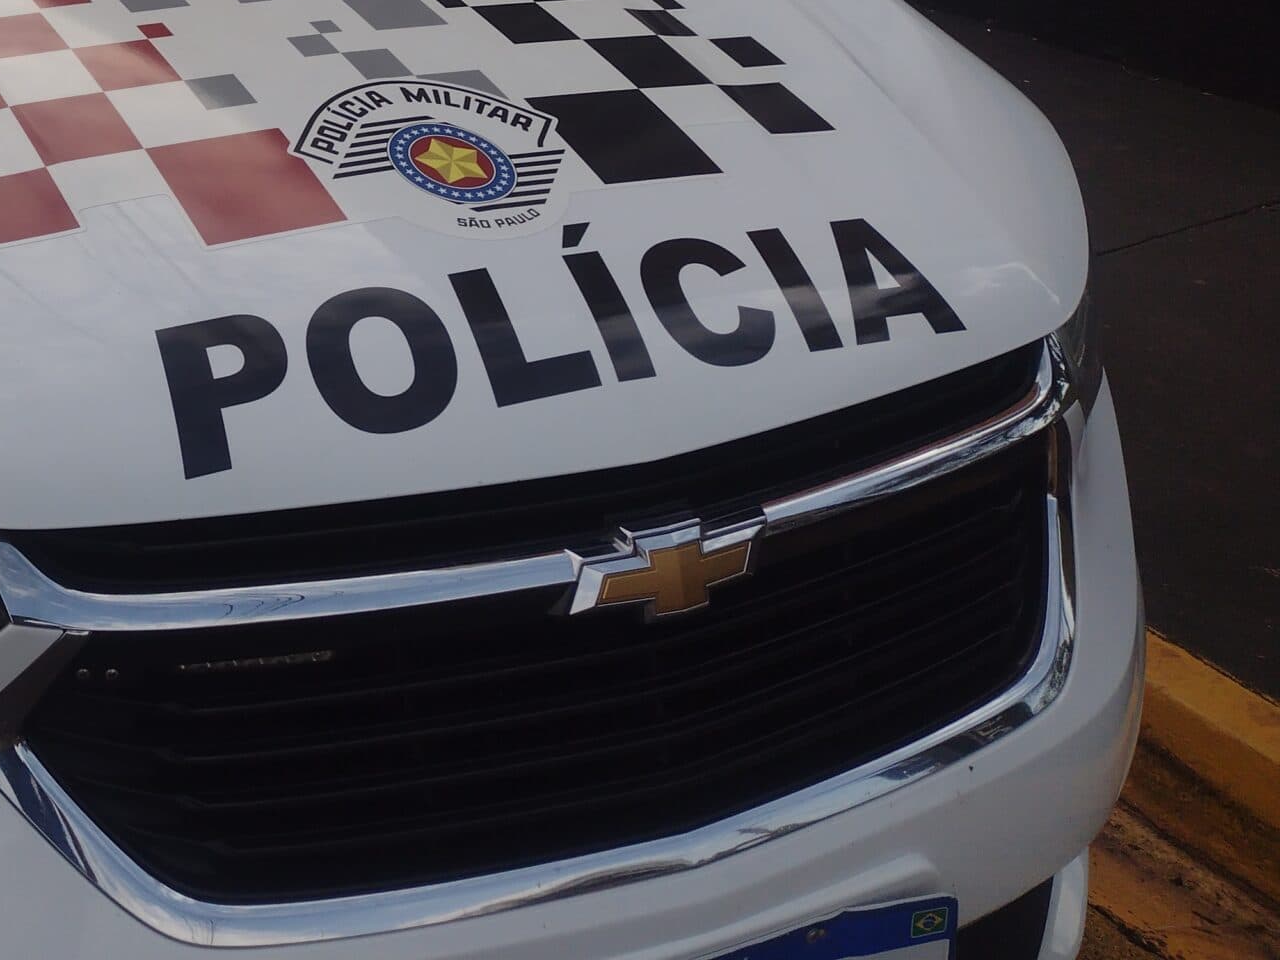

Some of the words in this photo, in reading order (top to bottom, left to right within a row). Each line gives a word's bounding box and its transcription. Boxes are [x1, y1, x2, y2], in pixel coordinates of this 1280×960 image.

[310, 90, 394, 155] POLÍCIA
[399, 86, 533, 132] MILITAR
[456, 216, 491, 229] SÃO
[496, 208, 541, 228] PAULO
[154, 217, 967, 480] POLÍCIA
